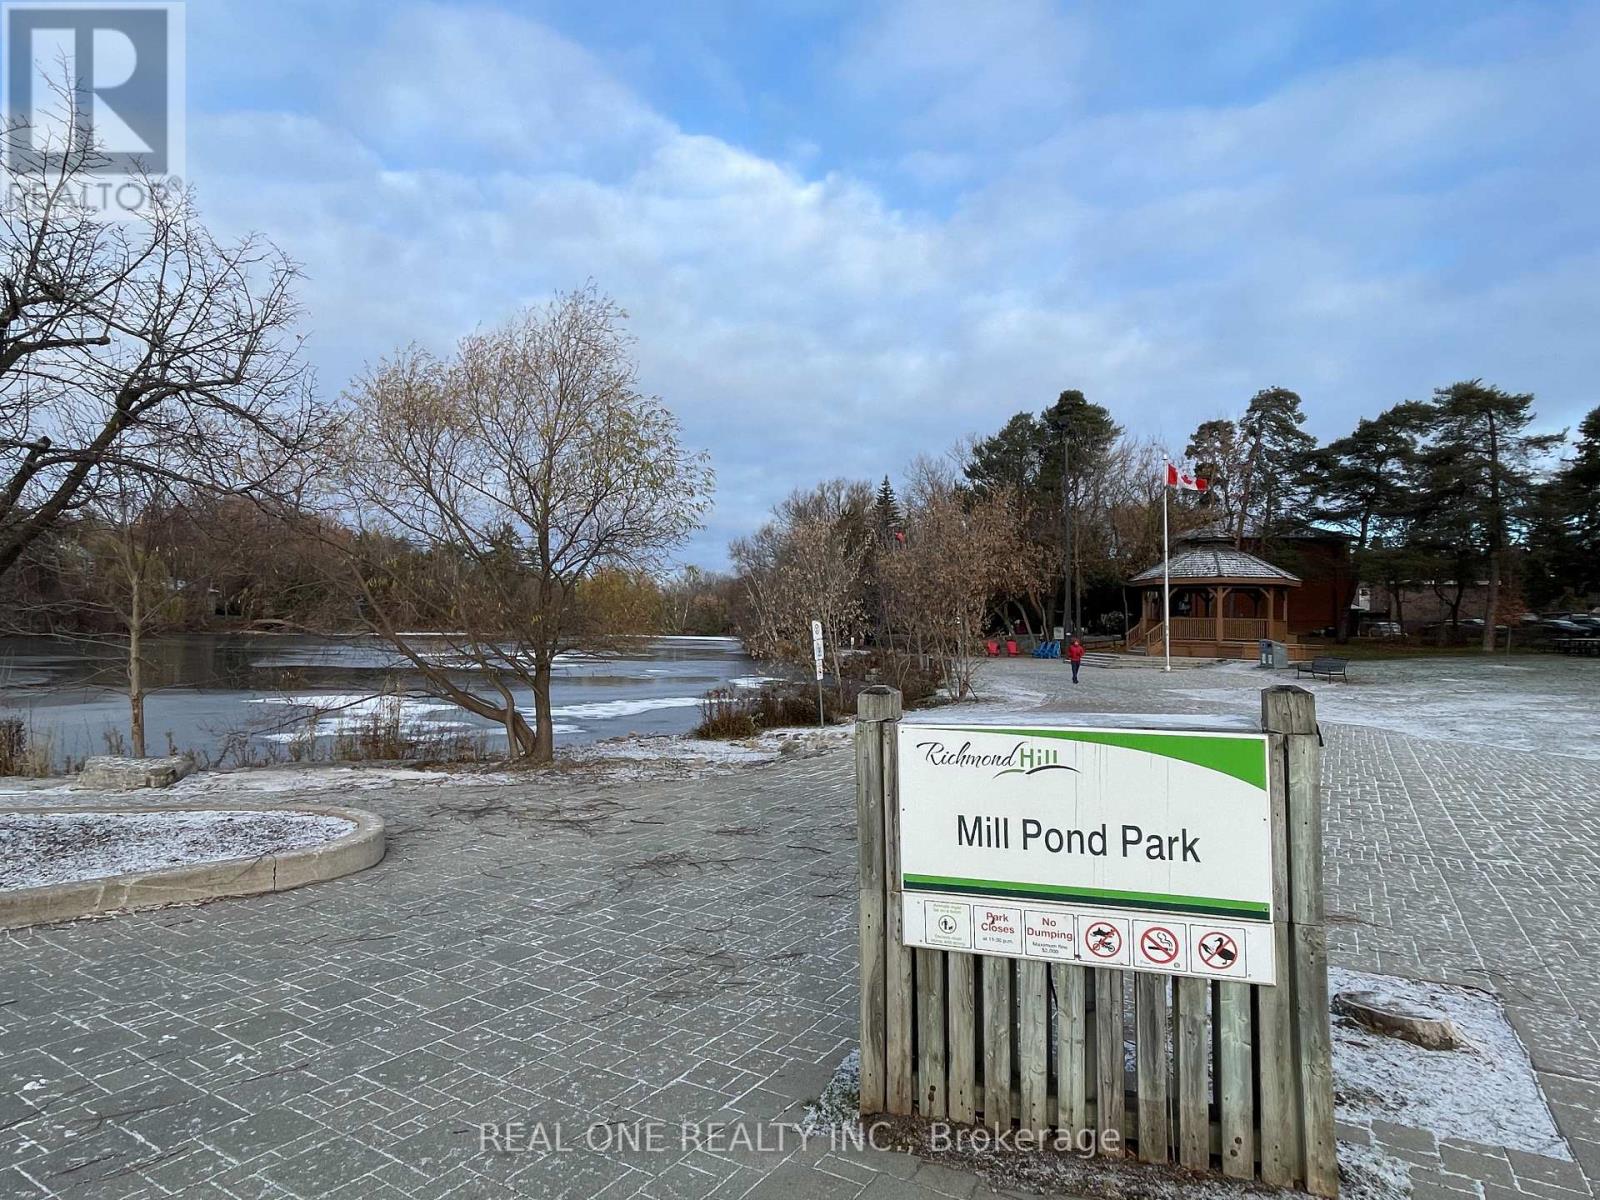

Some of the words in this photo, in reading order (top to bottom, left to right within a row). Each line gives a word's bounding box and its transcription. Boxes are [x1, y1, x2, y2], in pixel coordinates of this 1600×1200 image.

[916, 741, 1028, 768] Richmond
[1020, 747, 1058, 768] Hill
[957, 815, 1009, 849] Mill
[1022, 819, 1107, 856] Pond
[1121, 825, 1201, 862] Park
[986, 911, 1009, 922] Park
[1042, 917, 1057, 927] No
[980, 922, 1015, 934] Closes
[1027, 927, 1073, 942] Dumping
